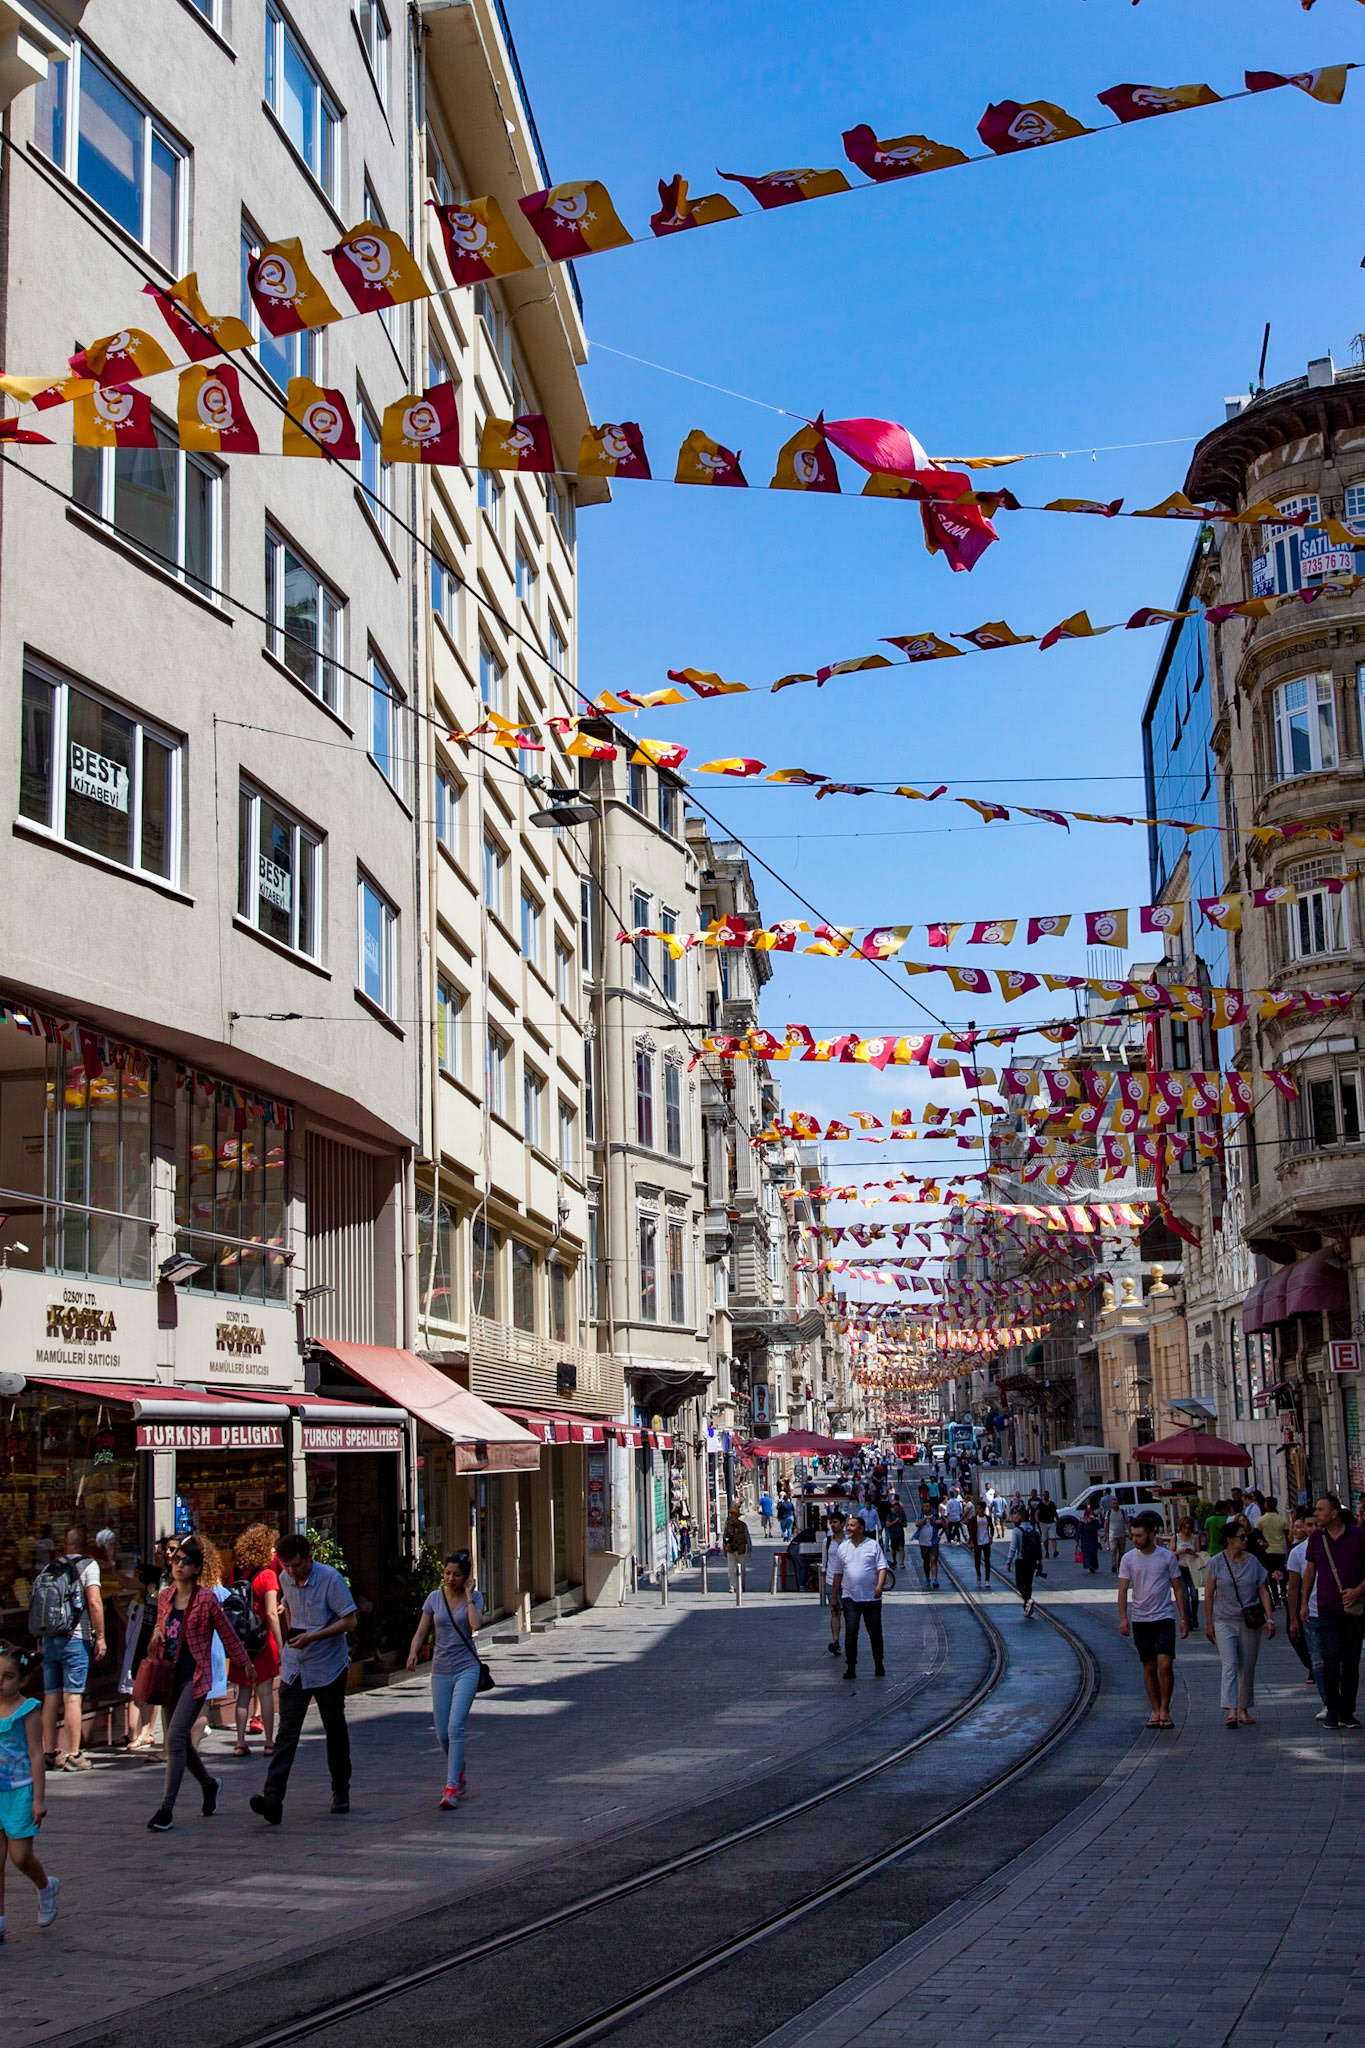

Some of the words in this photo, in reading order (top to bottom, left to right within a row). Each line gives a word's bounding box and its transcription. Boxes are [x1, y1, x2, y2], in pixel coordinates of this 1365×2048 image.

[1308, 557, 1323, 574] 735
[1325, 554, 1337, 569] 76
[1339, 553, 1351, 567] 73
[72, 744, 122, 789] BEST
[74, 775, 120, 808] KİTABEVİ
[259, 857, 287, 892] BEST
[84, 1292, 97, 1306] LTD.
[47, 1304, 117, 1333] KOSKA
[216, 1323, 266, 1346] KOSKA
[88, 1353, 121, 1367] SATICISI
[1339, 1346, 1354, 1367] E
[142, 1425, 211, 1446] TURKISH
[221, 1425, 278, 1445] DELIGHT
[303, 1428, 343, 1447] TURKISH
[345, 1427, 399, 1447] SPECIALITIES
